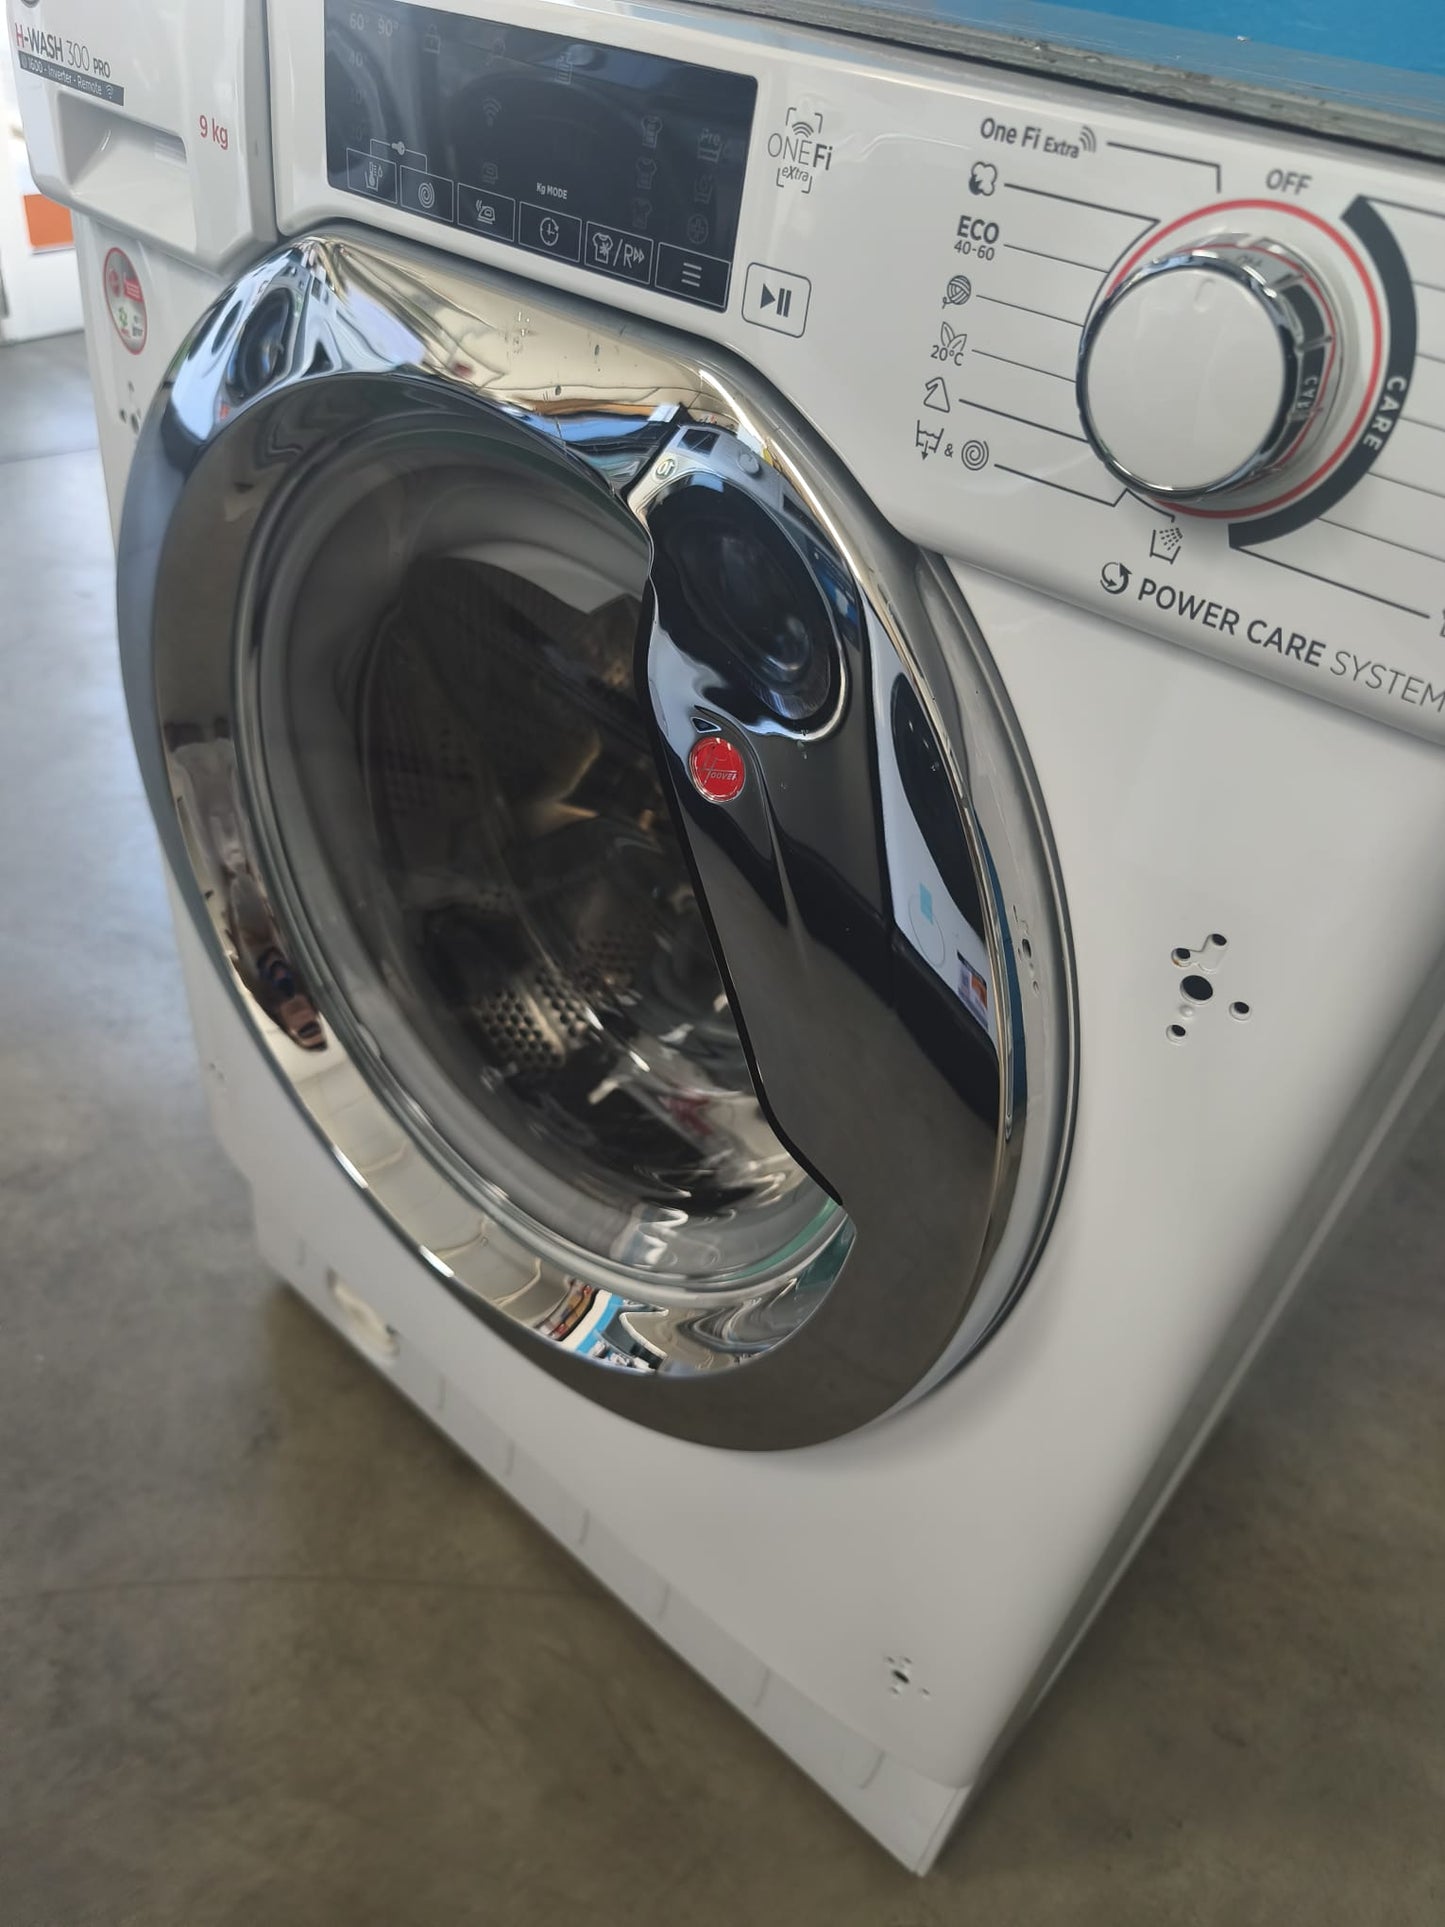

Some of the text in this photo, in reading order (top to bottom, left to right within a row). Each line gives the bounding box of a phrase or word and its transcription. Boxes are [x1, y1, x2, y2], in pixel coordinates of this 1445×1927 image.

[15, 22, 111, 78] H-WASH 300 PRO
[77, 75, 102, 96] Remote
[200, 114, 229, 150] 9 kg
[980, 117, 1080, 159] One Fi Extra
[547, 184, 568, 199] MODE
[1265, 168, 1312, 196] OFF
[957, 214, 1000, 245] ECO
[954, 240, 995, 261] 40-60
[1362, 375, 1407, 452] CARE
[944, 443, 954, 458] &
[1137, 578, 1445, 714] POWER CARE SYSTEM
